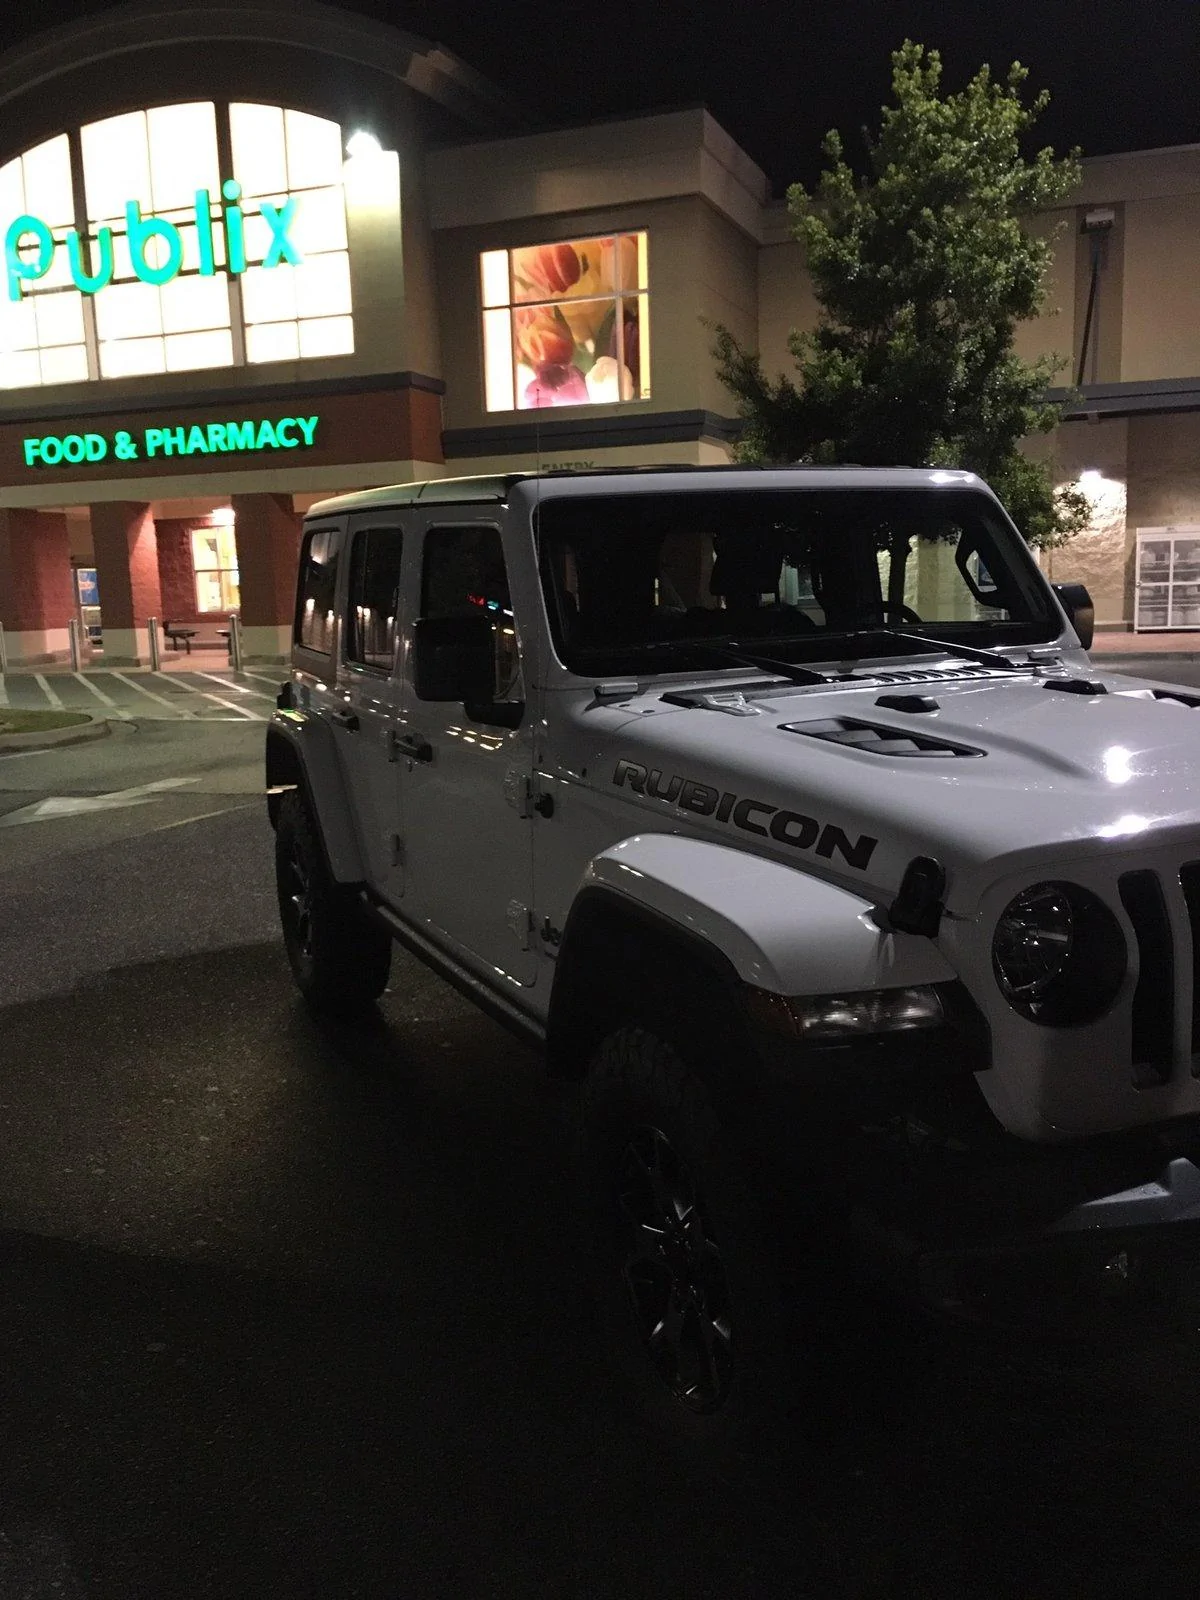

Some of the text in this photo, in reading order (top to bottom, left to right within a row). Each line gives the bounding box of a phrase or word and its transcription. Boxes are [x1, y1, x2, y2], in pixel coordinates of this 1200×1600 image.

[6, 180, 302, 300] Publix
[24, 416, 319, 465] FOOD & PHARMACY
[612, 759, 879, 871] RUBICON
